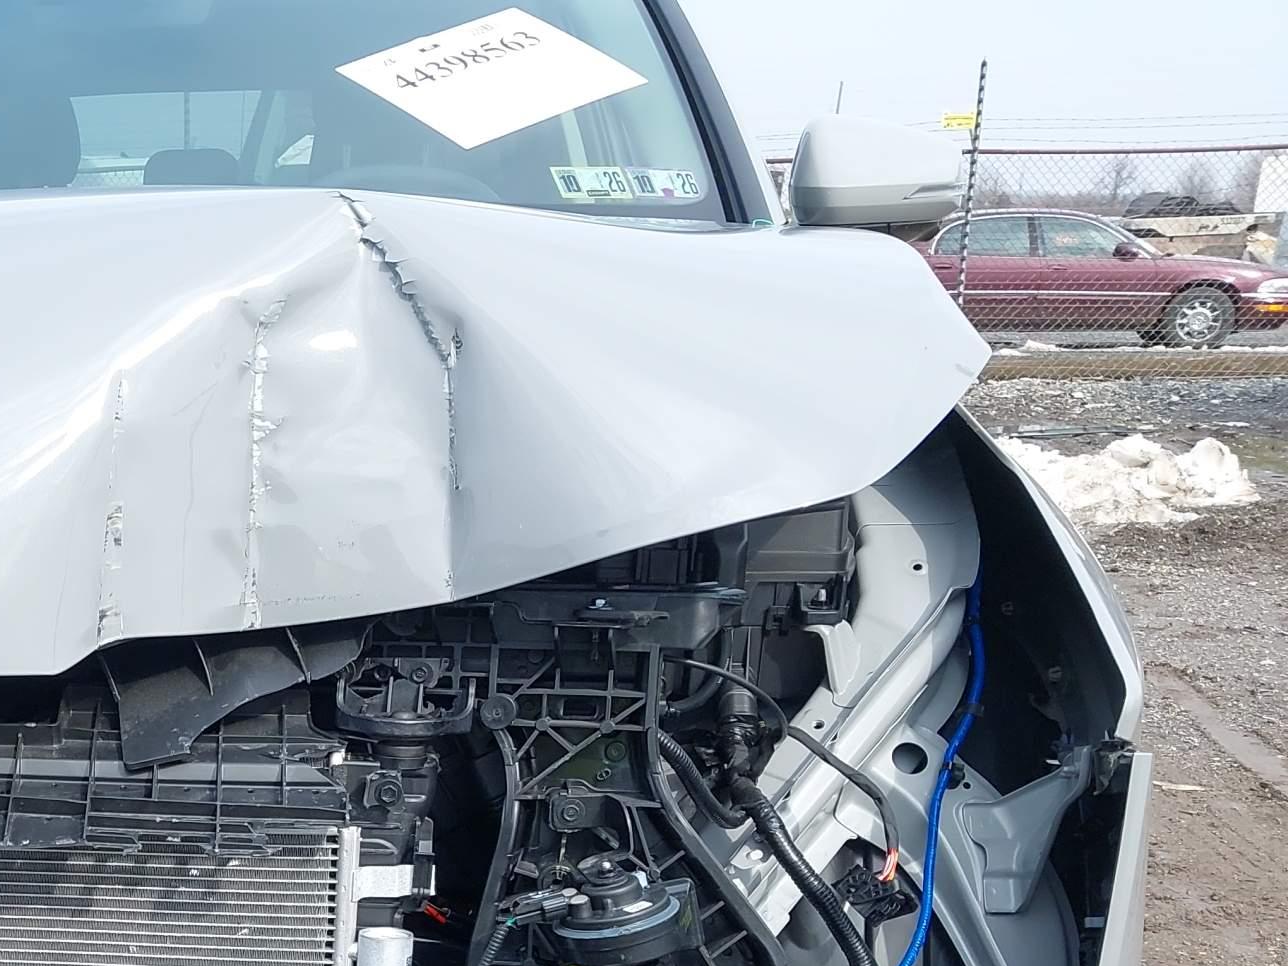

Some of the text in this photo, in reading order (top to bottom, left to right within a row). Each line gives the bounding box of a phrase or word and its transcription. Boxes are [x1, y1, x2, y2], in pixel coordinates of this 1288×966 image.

[395, 30, 541, 89] 44398563
[559, 171, 626, 193] 10 26
[633, 172, 699, 195] 10 26
